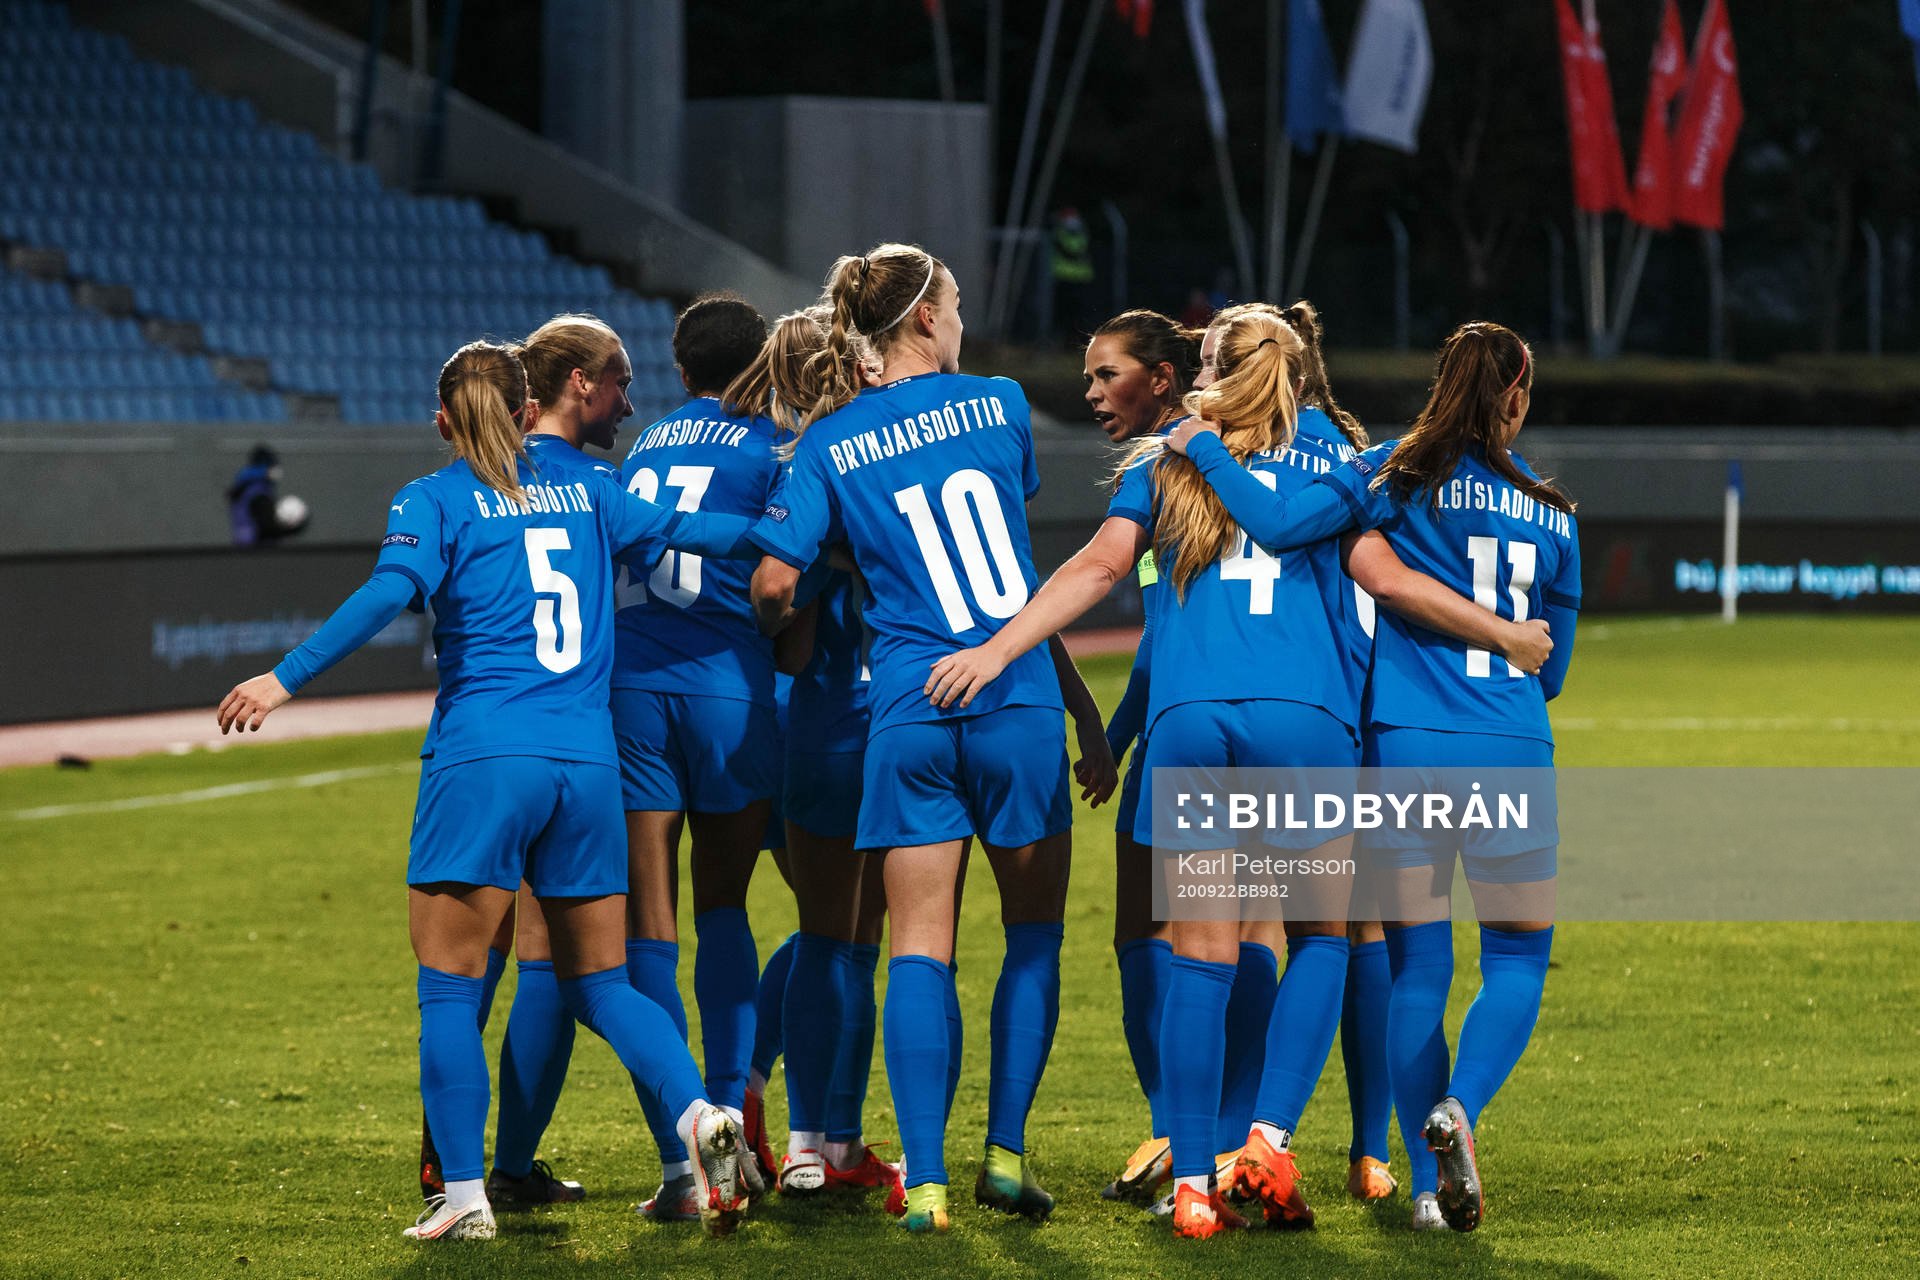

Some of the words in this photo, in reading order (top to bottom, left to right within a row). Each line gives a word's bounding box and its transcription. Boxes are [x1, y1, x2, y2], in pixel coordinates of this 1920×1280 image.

[828, 396, 1007, 476] BRYNJARSDÓTTIR
[524, 527, 582, 674] 5
[893, 468, 1029, 634] 10
[1220, 469, 1282, 615] 4
[1466, 535, 1537, 678] 11
